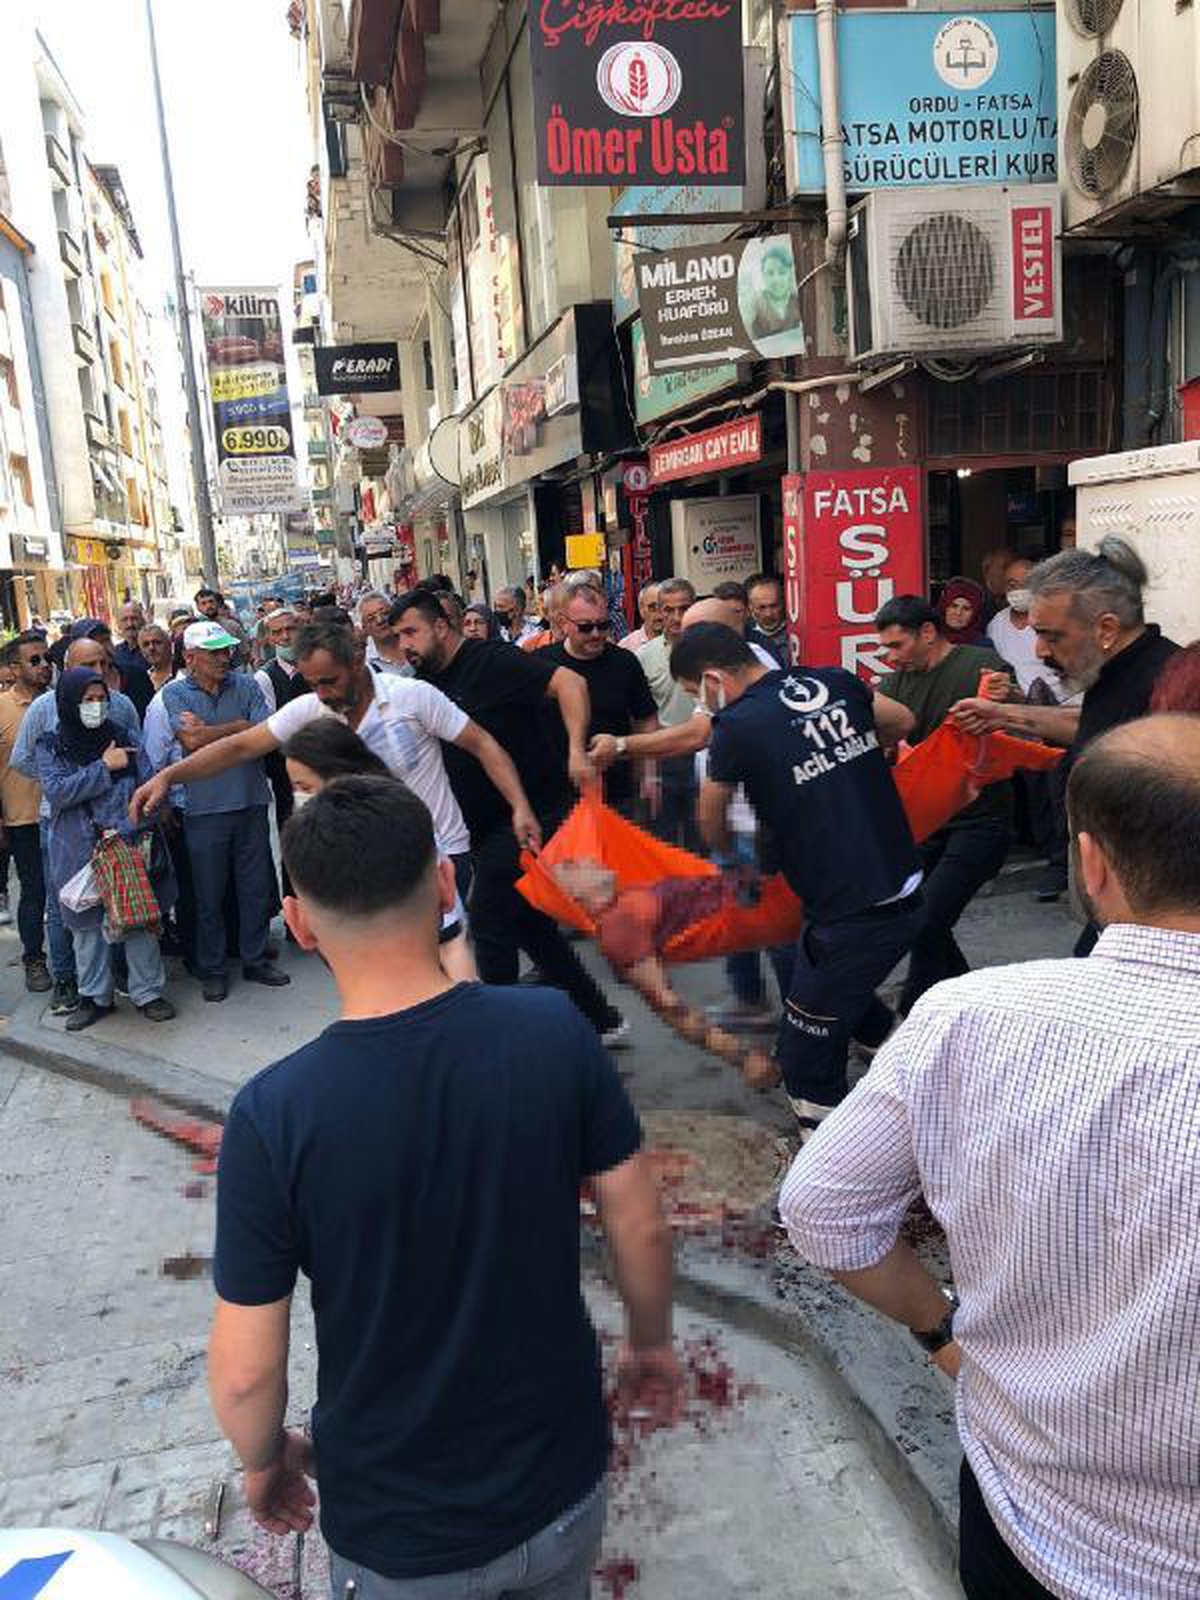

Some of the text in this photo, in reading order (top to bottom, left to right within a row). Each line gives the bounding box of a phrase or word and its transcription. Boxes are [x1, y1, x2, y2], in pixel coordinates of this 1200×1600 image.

[909, 96, 959, 114] ORDU
[976, 93, 1033, 112] FATSA
[546, 103, 643, 176] Ömer
[908, 116, 1028, 144] MOTORLU
[640, 254, 736, 289] MİLANO
[1022, 209, 1044, 316] VESTEL
[225, 296, 279, 315] kilim
[665, 285, 718, 305] ERKEK
[813, 487, 910, 518] FATSA
[803, 708, 857, 750] 112
[792, 751, 837, 785] ACİL
